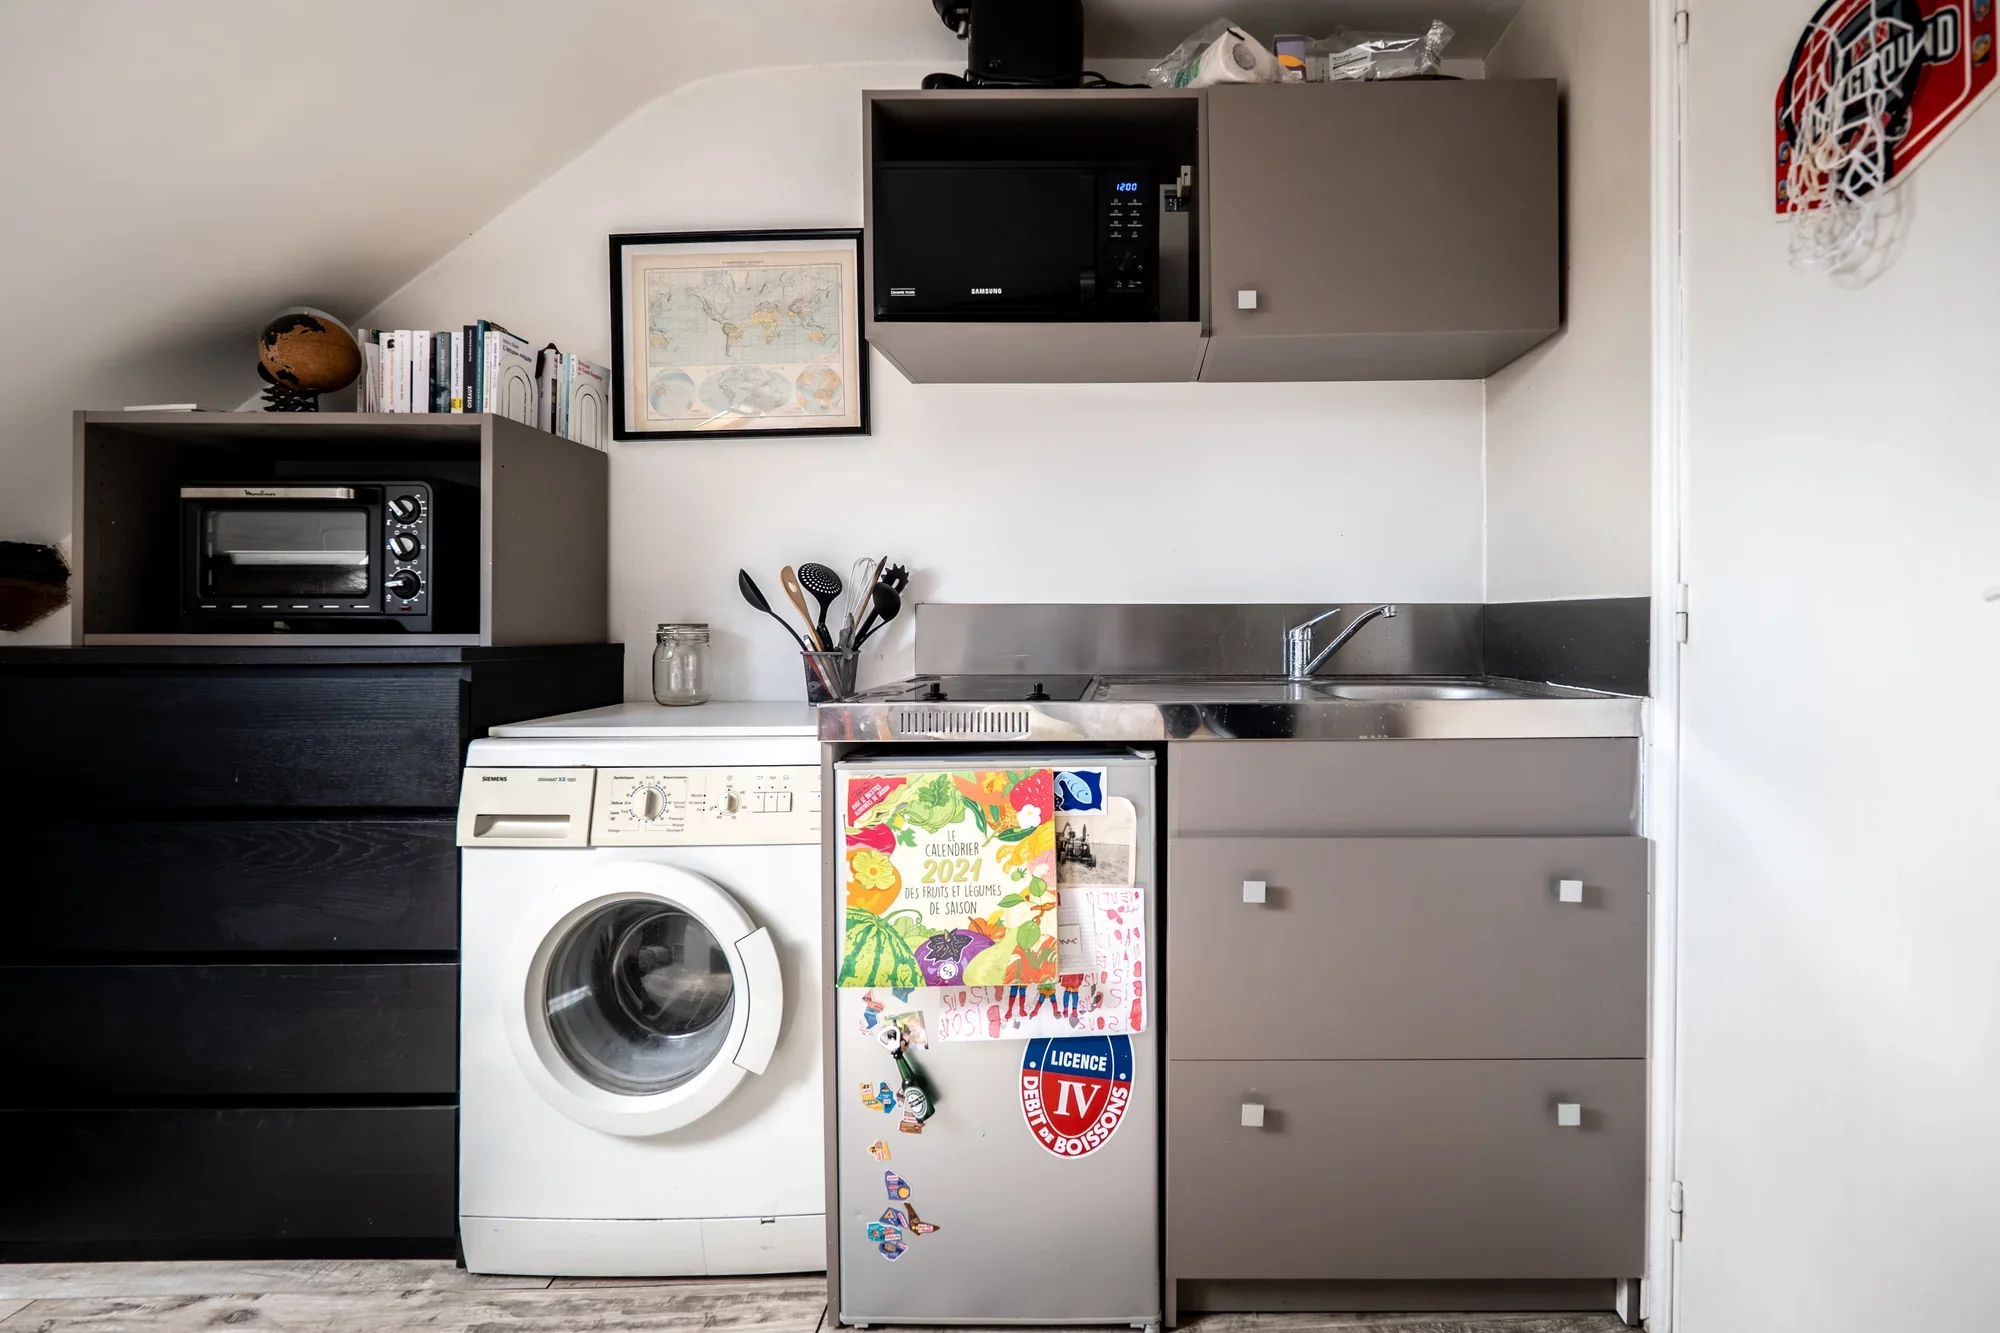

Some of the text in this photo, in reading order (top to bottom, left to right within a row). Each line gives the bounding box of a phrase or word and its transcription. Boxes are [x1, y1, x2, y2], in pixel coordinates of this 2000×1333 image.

[947, 830, 956, 844] LE
[925, 841, 980, 858] CALENDRIER
[921, 857, 983, 884] 2021
[904, 881, 1002, 900] DES FRUITS ET LÉGUMES
[929, 900, 977, 915] DE SAISON
[1051, 1050, 1108, 1072] LICENCE
[1053, 1080, 1102, 1119] IV
[1022, 1075, 1043, 1132] DEBIT
[1053, 1086, 1129, 1155] BOISSONS
